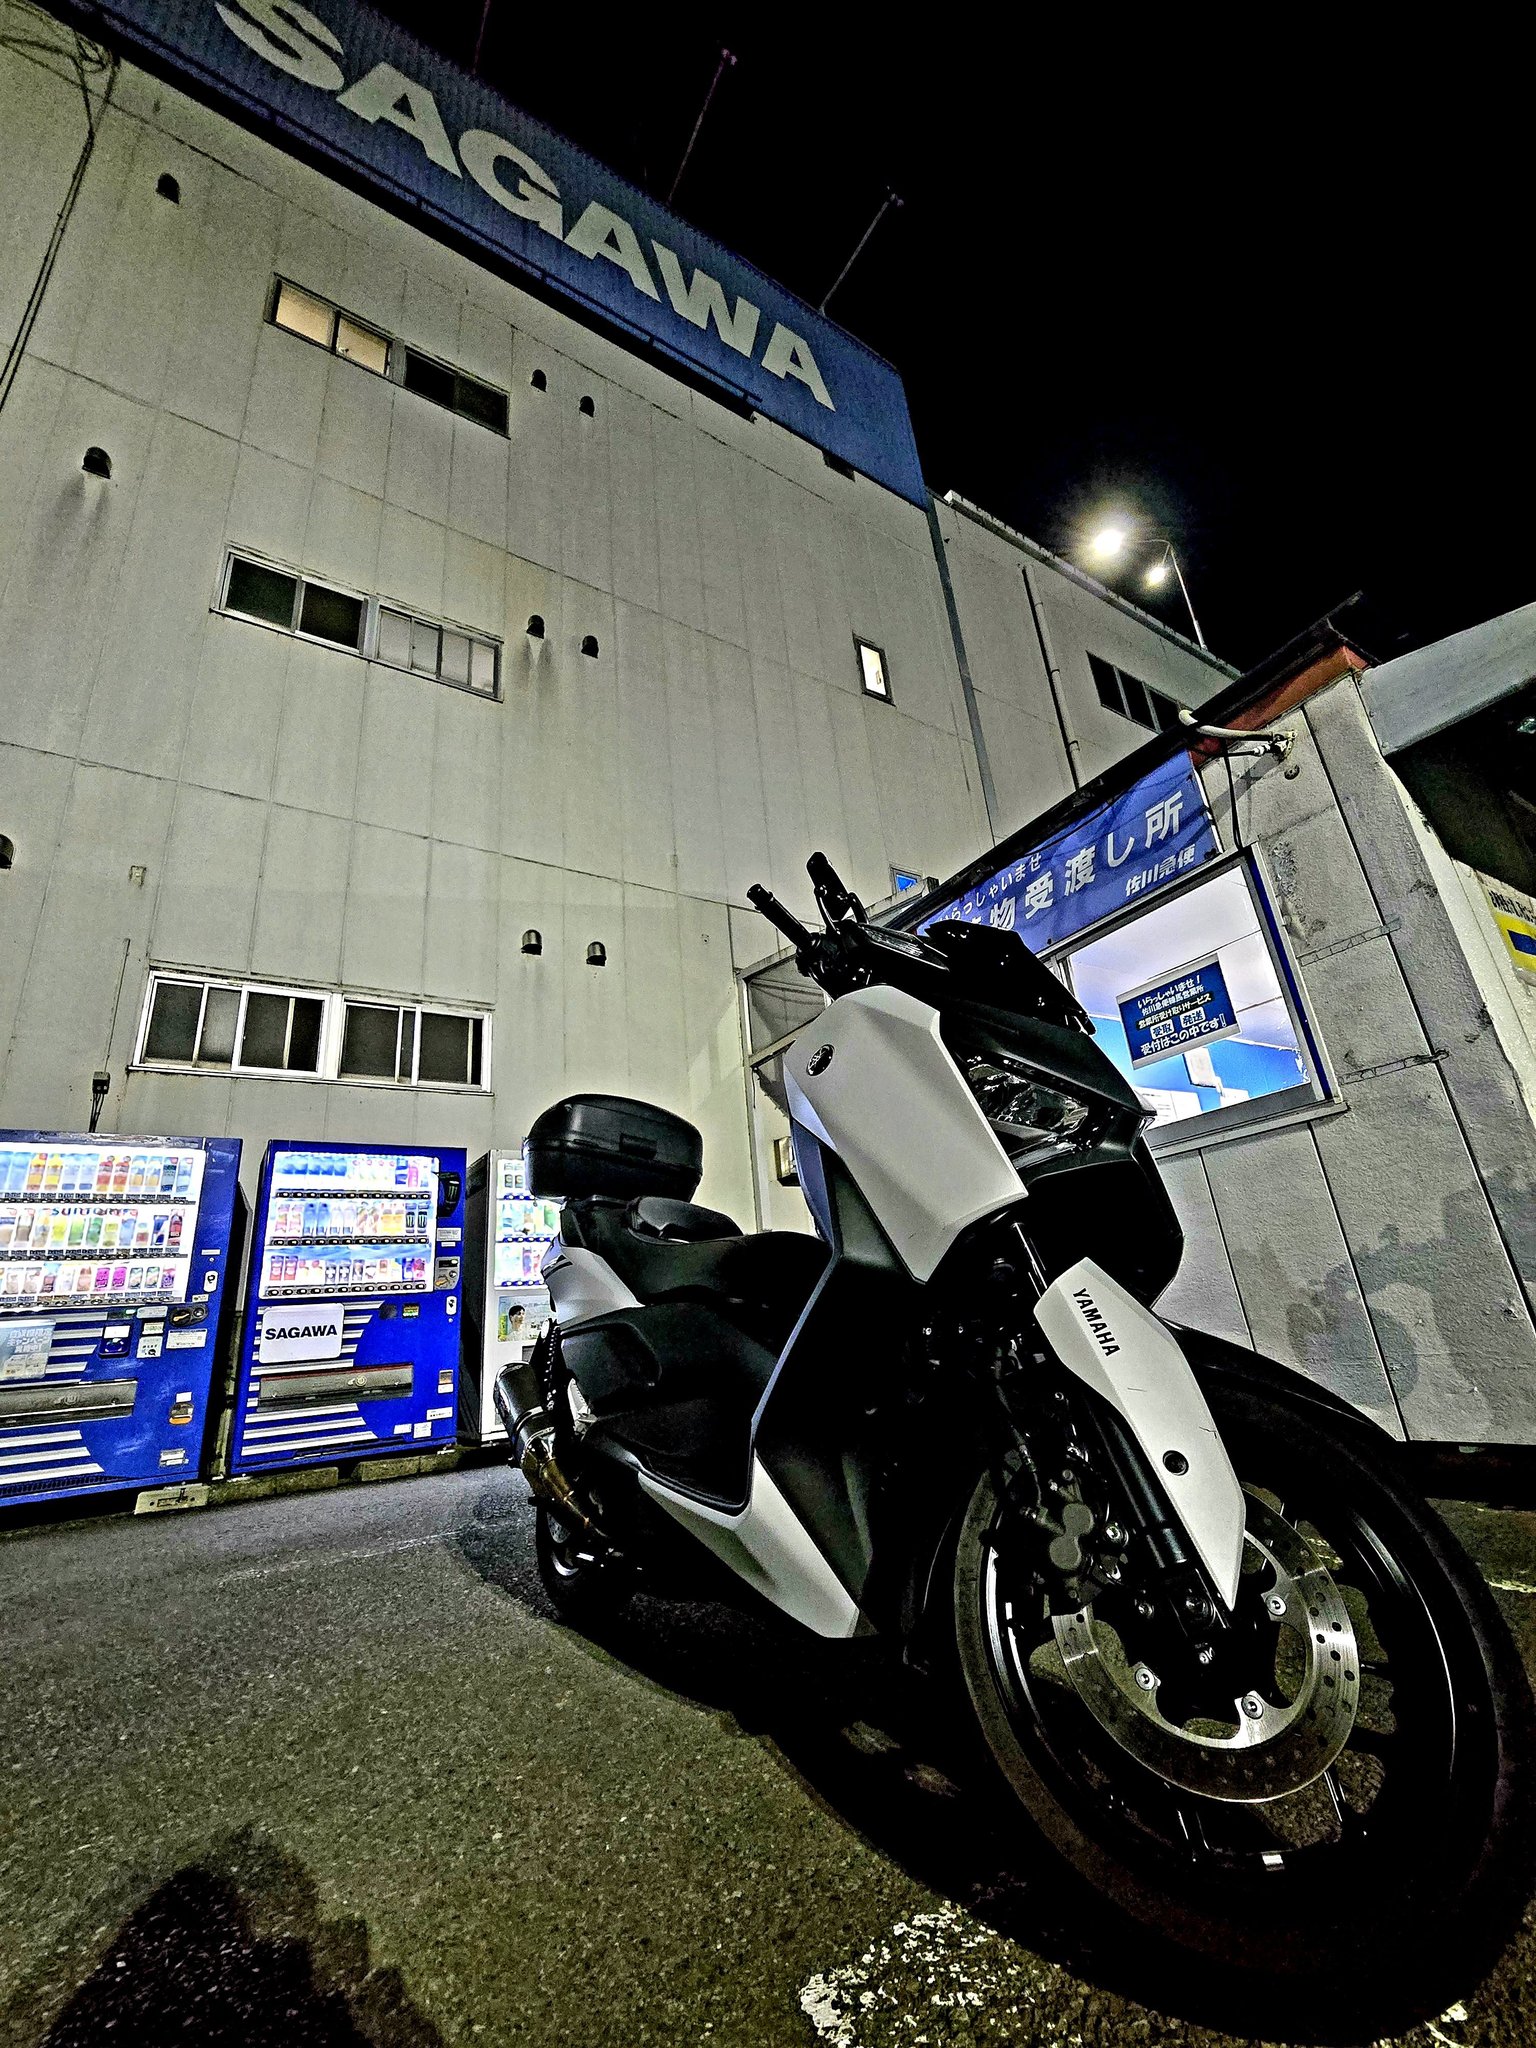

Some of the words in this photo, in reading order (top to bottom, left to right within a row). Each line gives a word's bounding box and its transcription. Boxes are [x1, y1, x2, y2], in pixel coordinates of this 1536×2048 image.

[215, 0, 836, 412] SAGAWA
[971, 790, 1183, 931] 物受渡し所
[1125, 843, 1196, 897] 佐川急便
[265, 1324, 338, 1340] SAGAWA
[1072, 1287, 1121, 1357] YAMAHA
